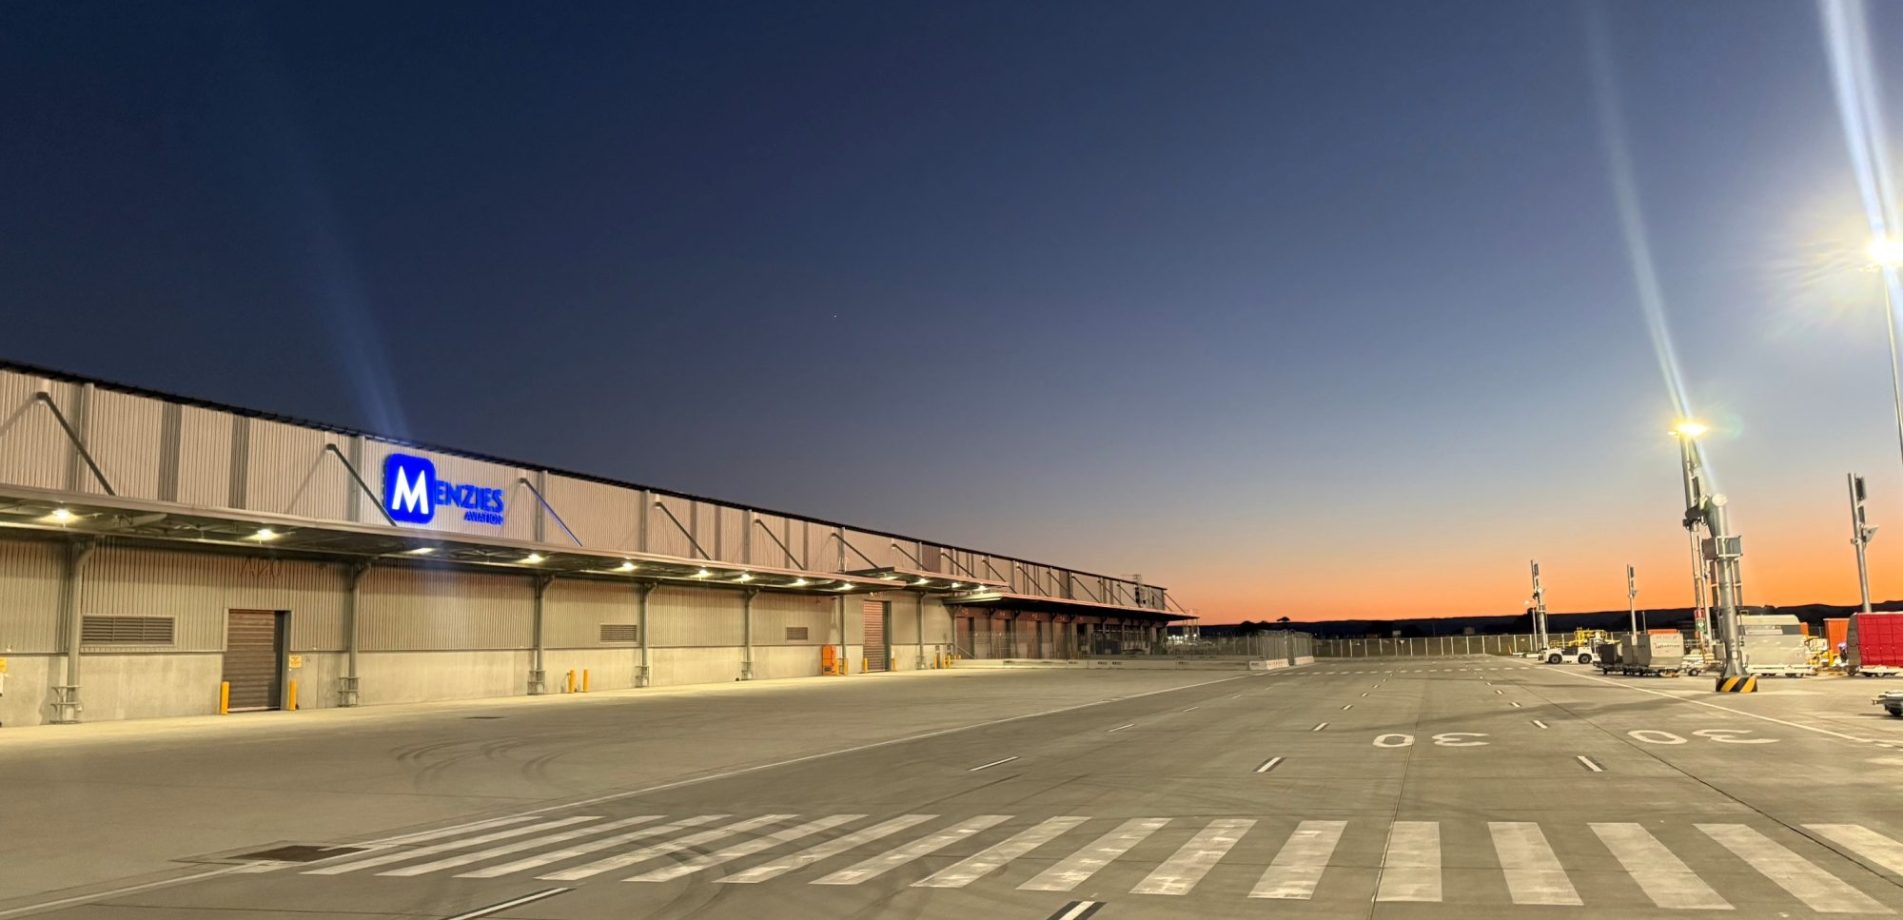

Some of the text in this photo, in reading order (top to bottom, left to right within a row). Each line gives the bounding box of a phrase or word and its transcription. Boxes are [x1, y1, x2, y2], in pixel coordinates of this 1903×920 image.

[390, 463, 504, 514] MENZIES
[1373, 732, 1490, 748] 30
[1627, 729, 1782, 745] 30
